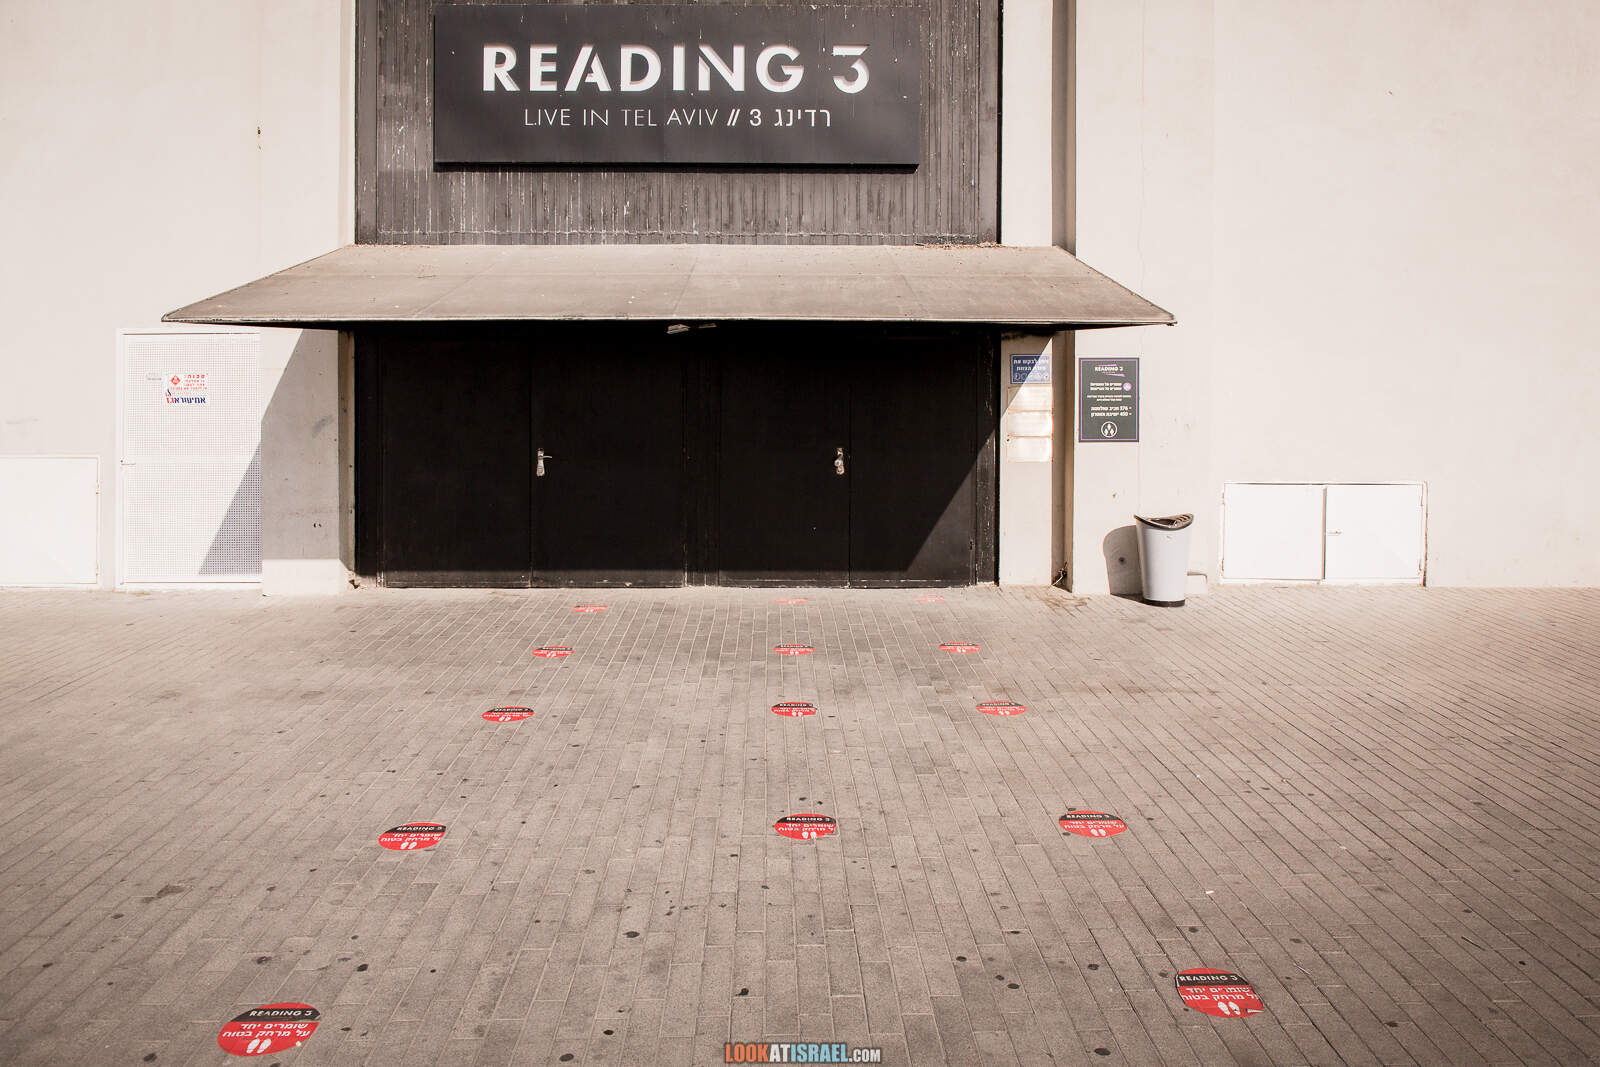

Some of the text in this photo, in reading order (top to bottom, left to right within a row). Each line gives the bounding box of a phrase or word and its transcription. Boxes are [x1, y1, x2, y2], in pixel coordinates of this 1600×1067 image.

[483, 44, 870, 94] READING 3
[524, 108, 571, 127] LIVE
[583, 108, 608, 127] IN
[620, 108, 657, 127] TEL
[667, 108, 719, 127] AVIV
[749, 108, 762, 127] 3
[774, 108, 832, 127] רדינג
[222, 1030, 253, 1038] בטוח
[256, 1030, 291, 1038] מרחק
